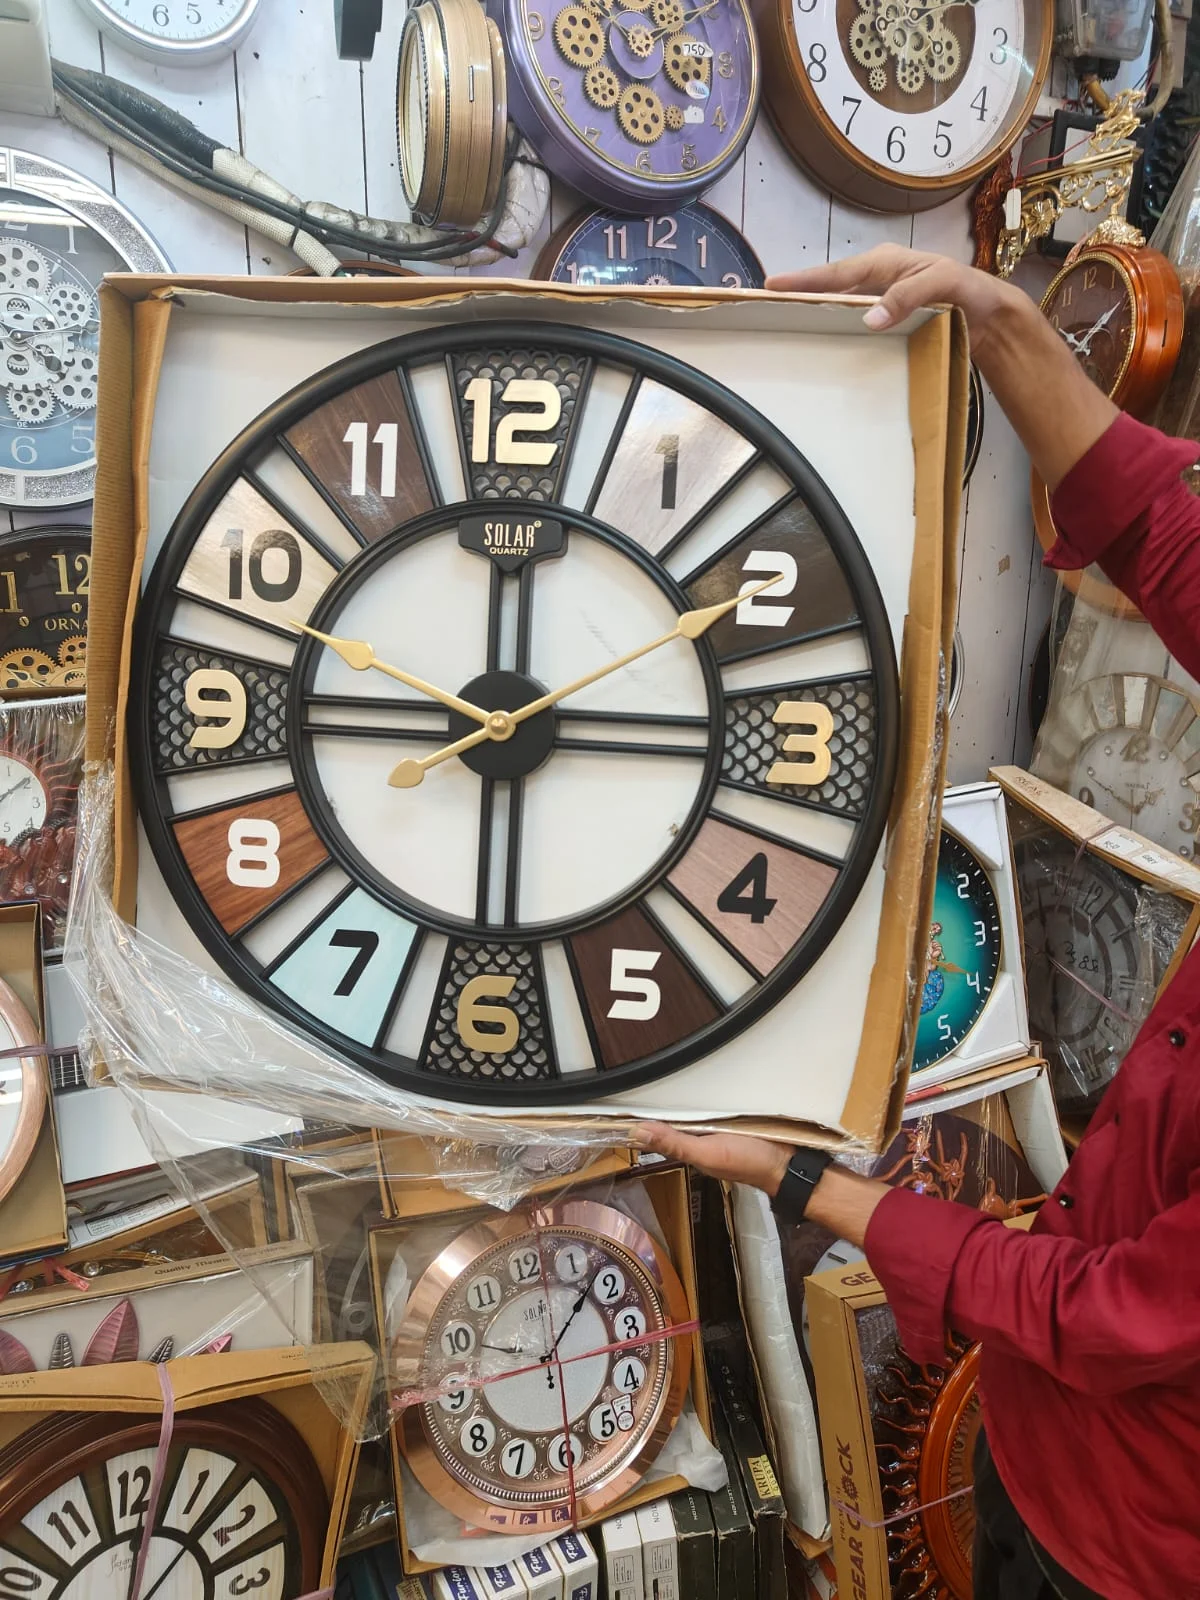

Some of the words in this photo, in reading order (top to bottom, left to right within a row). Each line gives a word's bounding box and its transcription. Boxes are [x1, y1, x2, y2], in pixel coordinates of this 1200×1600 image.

[153, 4, 170, 27] 6
[186, 2, 202, 25] 5
[806, 42, 827, 83] 8
[989, 27, 1008, 65] 3
[842, 95, 862, 136] 7
[969, 85, 989, 122] 4
[886, 126, 907, 163] 6
[933, 120, 954, 158] 5
[681, 143, 700, 171] 5
[603, 224, 627, 260] 11
[644, 214, 679, 250] 12
[697, 234, 708, 269] 1
[463, 378, 562, 465] 12
[11, 435, 38, 465] 6
[70, 425, 96, 454] 5
[343, 422, 399, 498] 11
[654, 433, 681, 510] 1
[484, 522, 535, 548] SOLAR
[489, 547, 529, 556] QUARTZ
[220, 528, 303, 603] 10
[735, 549, 799, 628] 2
[184, 668, 248, 750] 9
[764, 700, 835, 786] 3
[32, 796, 41, 809] 3
[3, 821, 11, 833] 5
[225, 817, 281, 889] 8
[716, 851, 779, 924] 4
[956, 873, 971, 899] 2
[972, 920, 986, 946] 3
[328, 928, 380, 997] 7
[606, 948, 662, 1022] 5
[966, 970, 981, 994] 4
[456, 974, 521, 1054] 6
[937, 1014, 951, 1040] 5
[513, 1252, 541, 1284] 12
[566, 1252, 579, 1275] 1
[840, 1271, 877, 1287] GE
[473, 1281, 497, 1309] 11
[602, 1273, 619, 1300] 2
[445, 1327, 471, 1356] 10
[623, 1314, 640, 1339] 3
[623, 1363, 640, 1391] 4
[469, 1423, 488, 1453] 8
[600, 1408, 616, 1438] 5
[508, 1445, 525, 1476] 7
[556, 1440, 576, 1469] 6
[117, 1465, 151, 1520] 12
[182, 1469, 210, 1515] 1
[753, 1460, 772, 1497] KRUPA
[47, 1500, 91, 1550] 11
[213, 1504, 256, 1547] 2
[228, 1567, 271, 1596] 3
[848, 1538, 867, 1600] GEAR
